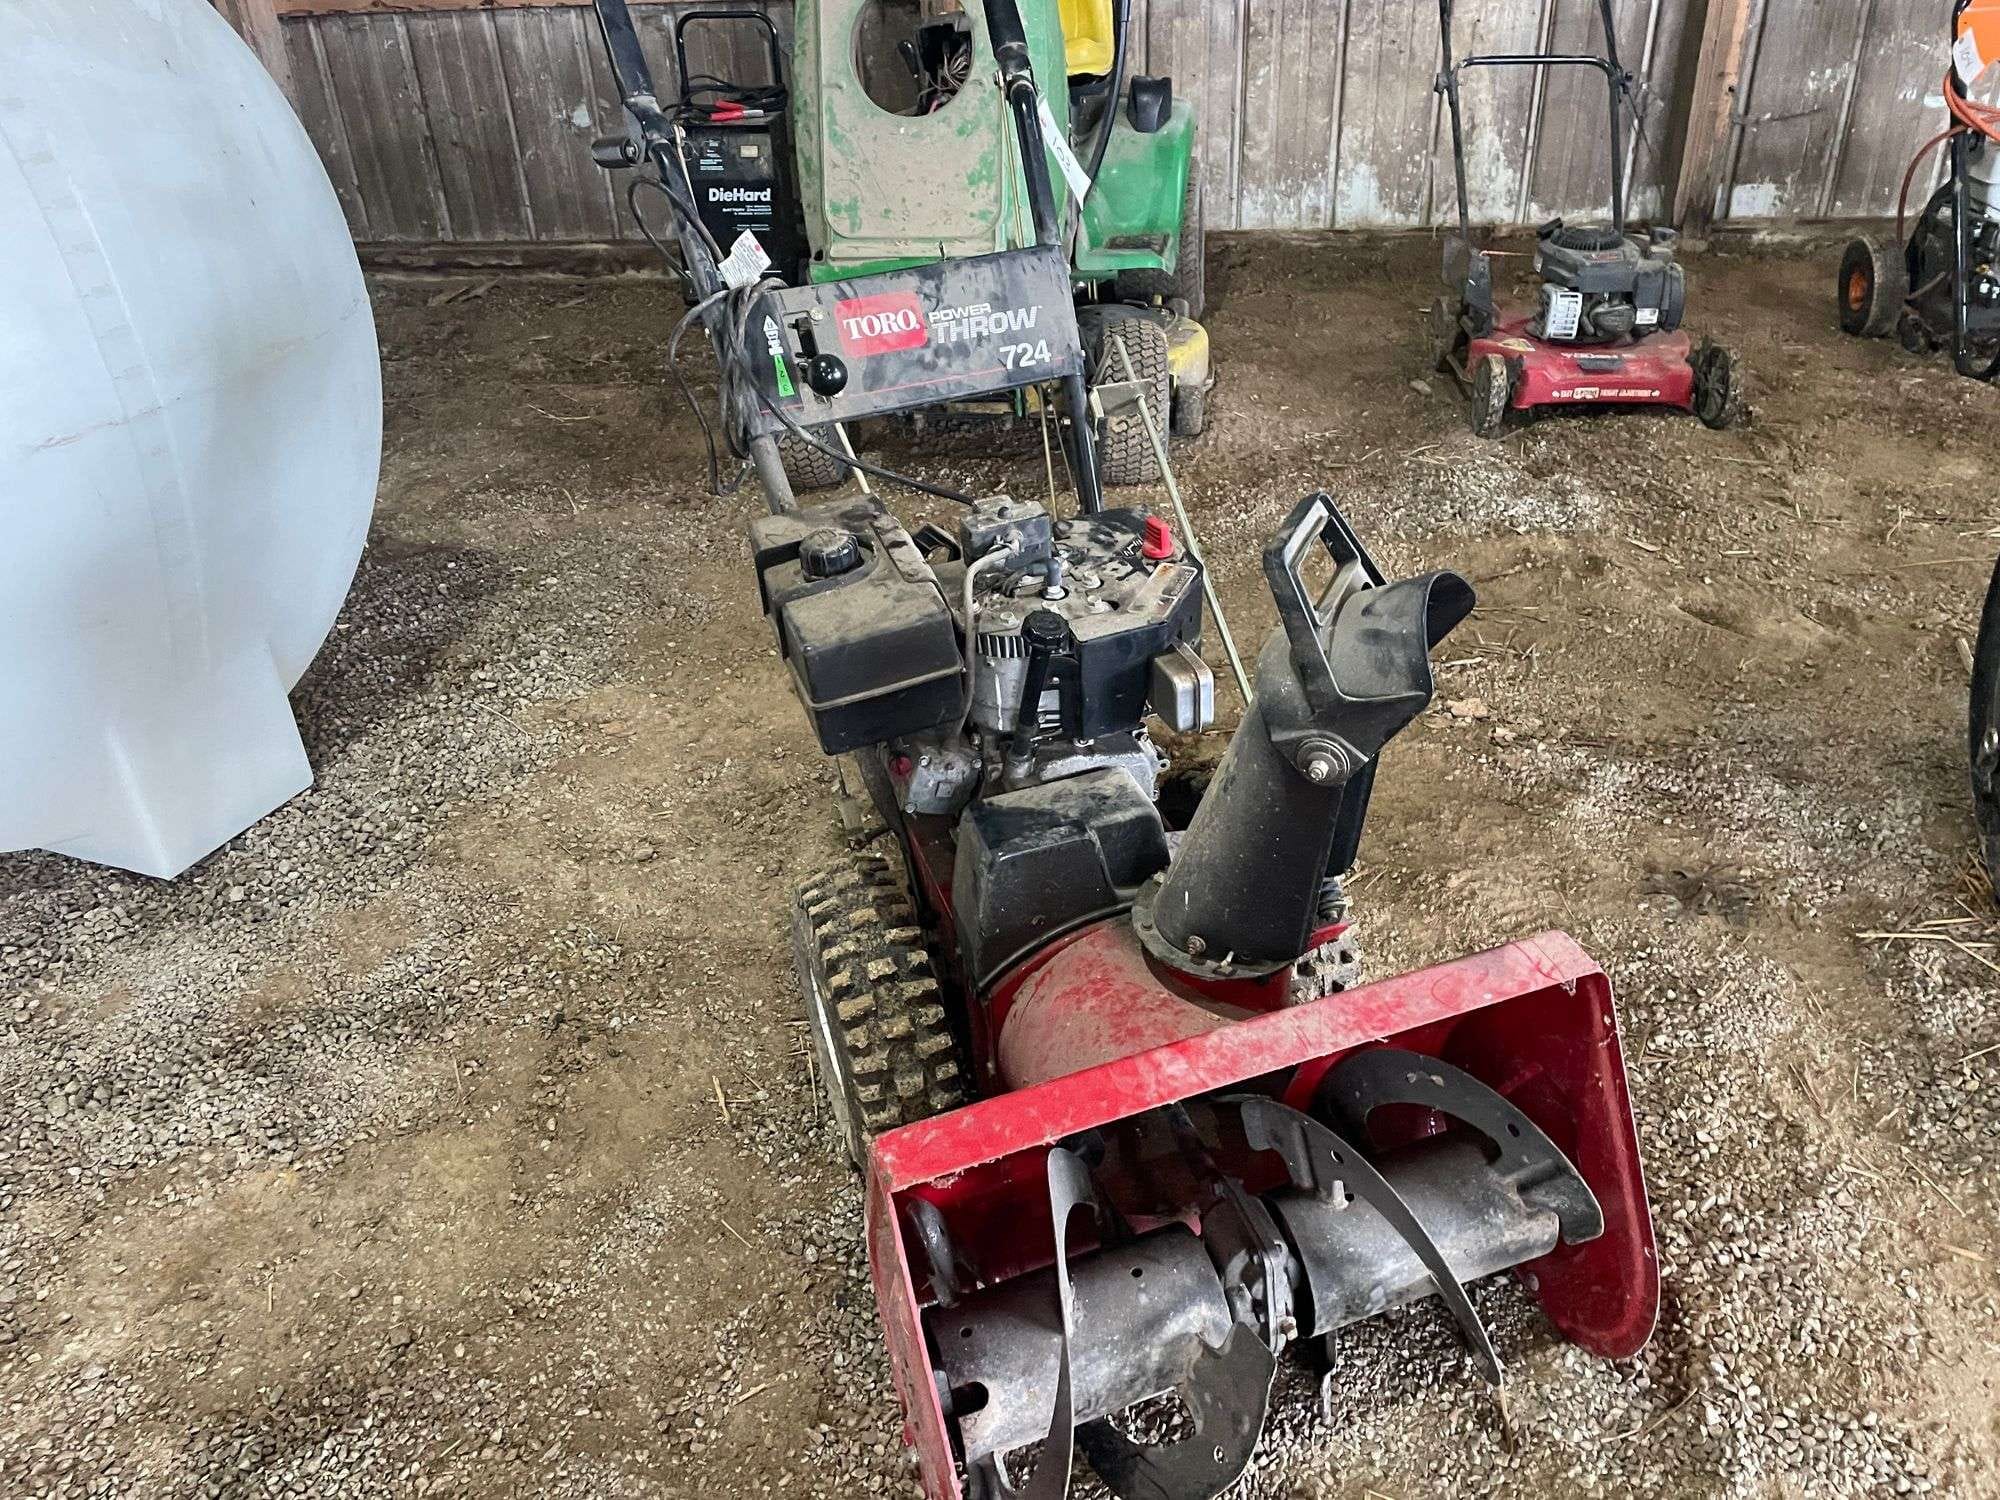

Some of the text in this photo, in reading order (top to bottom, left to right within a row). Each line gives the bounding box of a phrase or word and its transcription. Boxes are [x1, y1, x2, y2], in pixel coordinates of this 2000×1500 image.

[708, 187, 771, 202] DieHard
[842, 308, 920, 340] TORO
[928, 302, 992, 323] POWER
[931, 305, 1039, 344] THROW
[1000, 338, 1052, 370] 724
